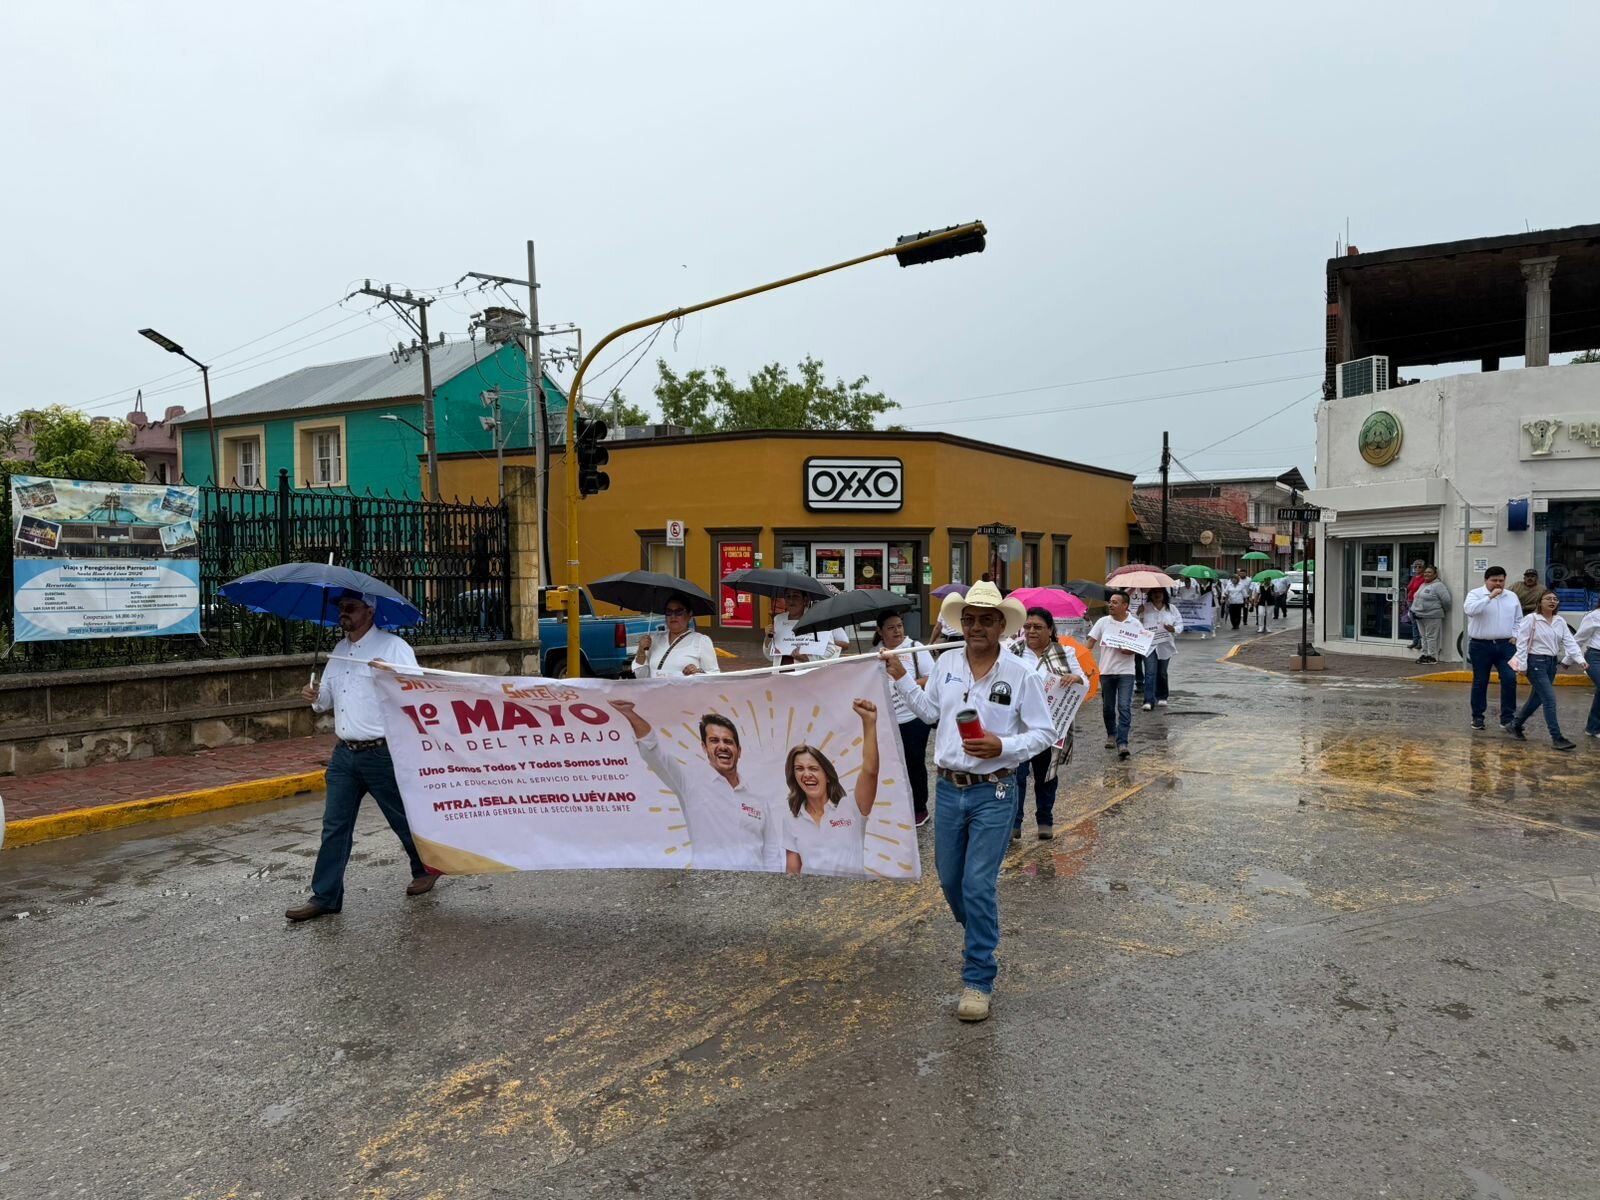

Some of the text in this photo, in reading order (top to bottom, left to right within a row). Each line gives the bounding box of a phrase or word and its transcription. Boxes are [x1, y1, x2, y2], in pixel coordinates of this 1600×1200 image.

[812, 468, 898, 500] OXXO
[1280, 510, 1298, 519] SANTA
[1304, 510, 1318, 520] ROSA
[84, 564, 126, 572] Peregrinación
[501, 683, 551, 699] SNTE
[451, 699, 610, 735] MAYO
[467, 737, 508, 751] DEL
[518, 730, 620, 747] TRABAJO
[419, 757, 629, 777] ¡Uno Somos Todos Y Todos Somos Uno!
[464, 778, 514, 787] EDUCACIÓN
[529, 775, 570, 783] SERVICIO
[572, 774, 589, 782] DEL
[433, 790, 636, 812] MTRA. ISELA LICERIO LUÉVANO
[444, 809, 491, 821] SECRETARIA
[493, 806, 526, 816] GENERAL
[528, 806, 538, 814] DE
[540, 805, 549, 813] LA
[551, 804, 582, 813] SECCIÓN
[612, 804, 631, 812] SNTE
